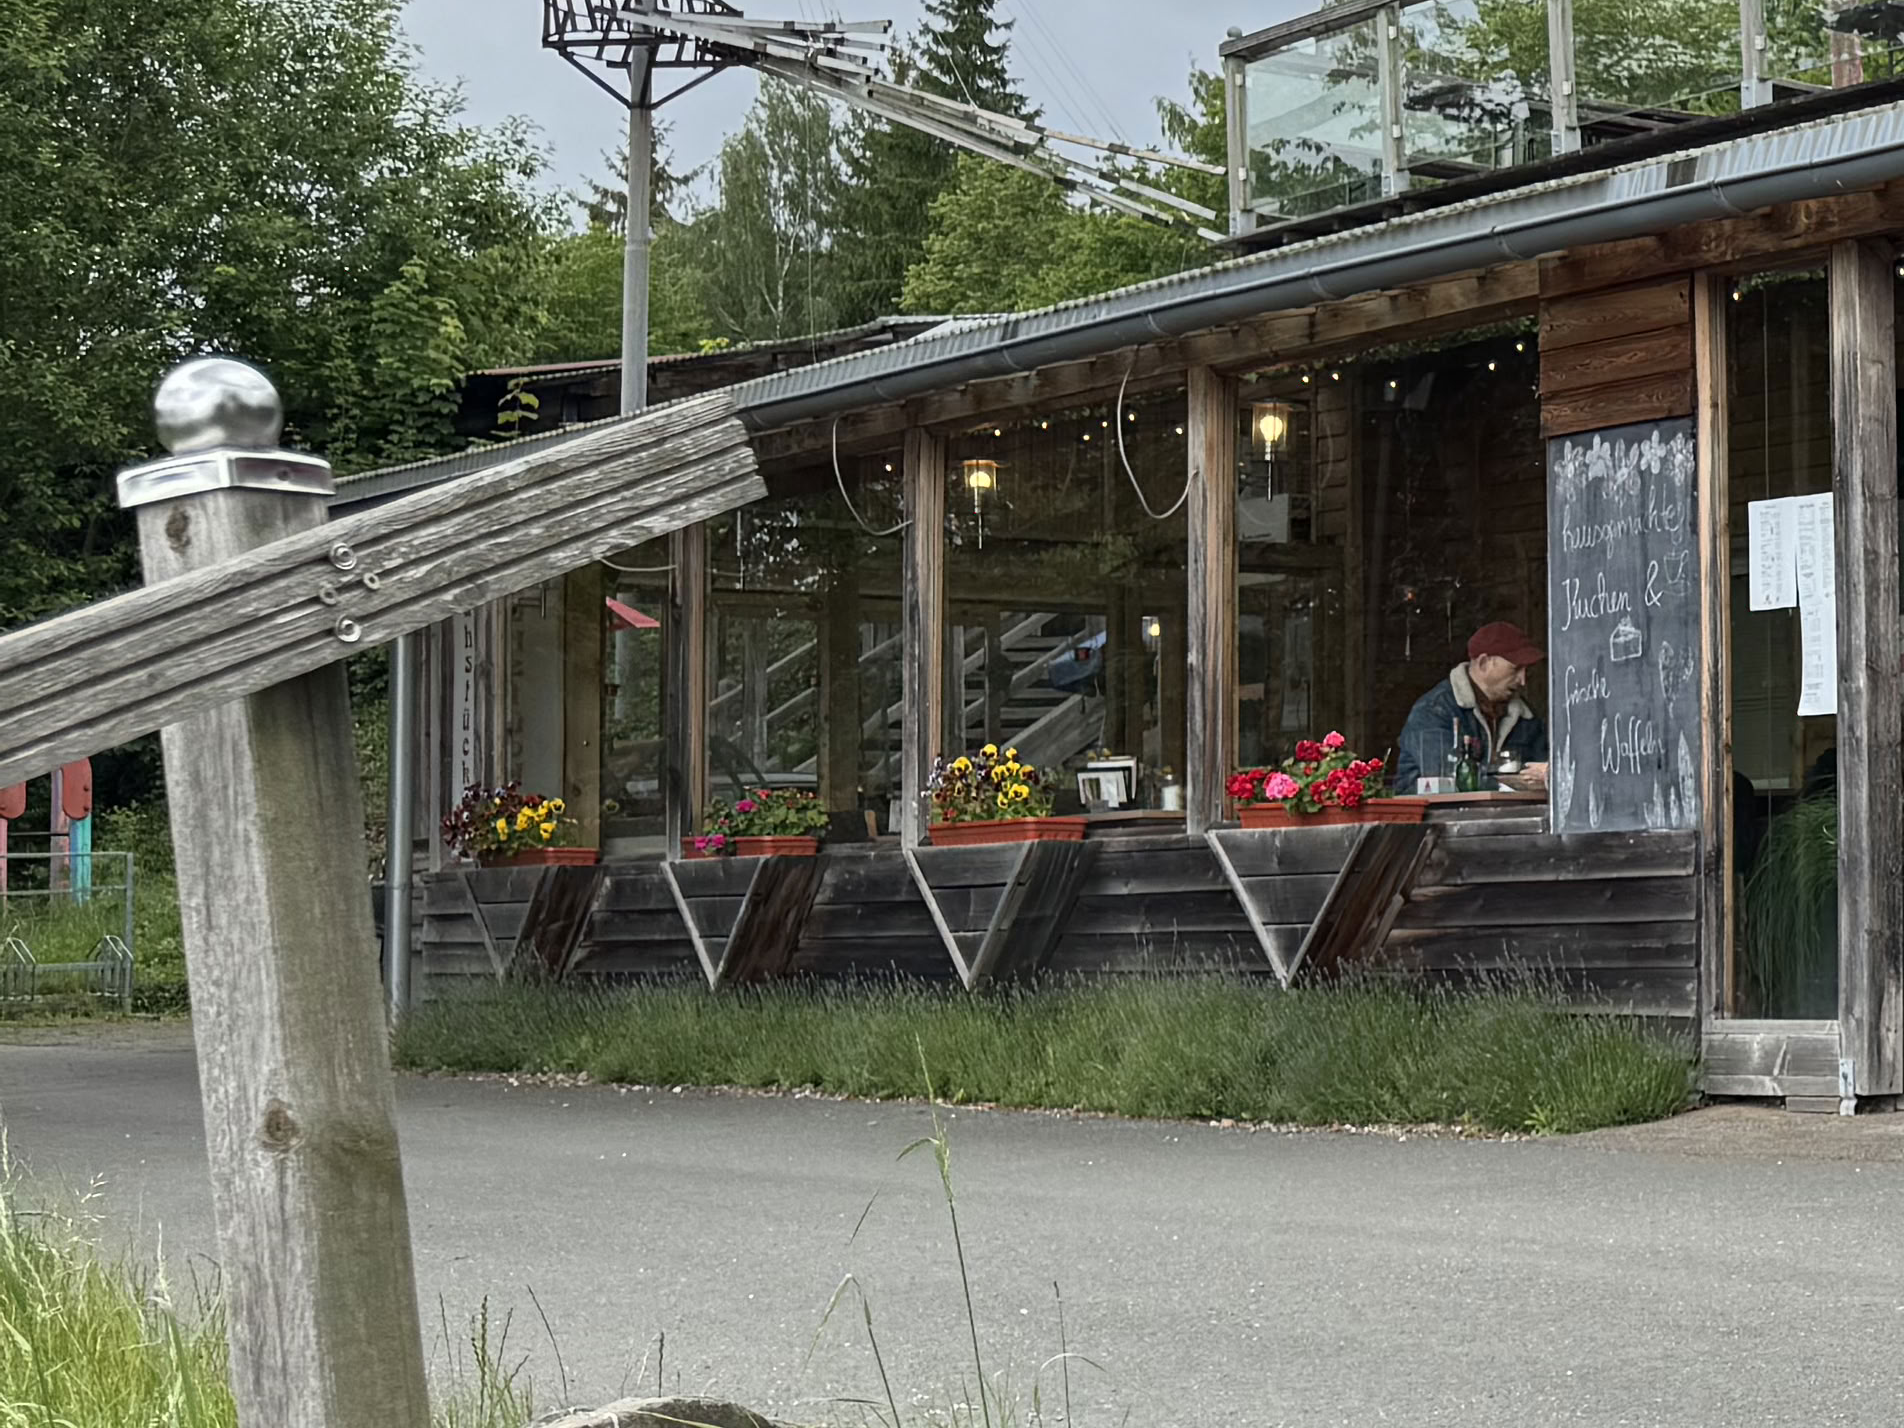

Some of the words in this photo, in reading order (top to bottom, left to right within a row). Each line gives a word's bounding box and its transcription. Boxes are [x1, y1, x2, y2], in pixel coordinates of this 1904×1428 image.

[1561, 572, 1632, 631] Kuchen
[1644, 560, 1664, 607] &
[1600, 712, 1666, 775] Waffeln
